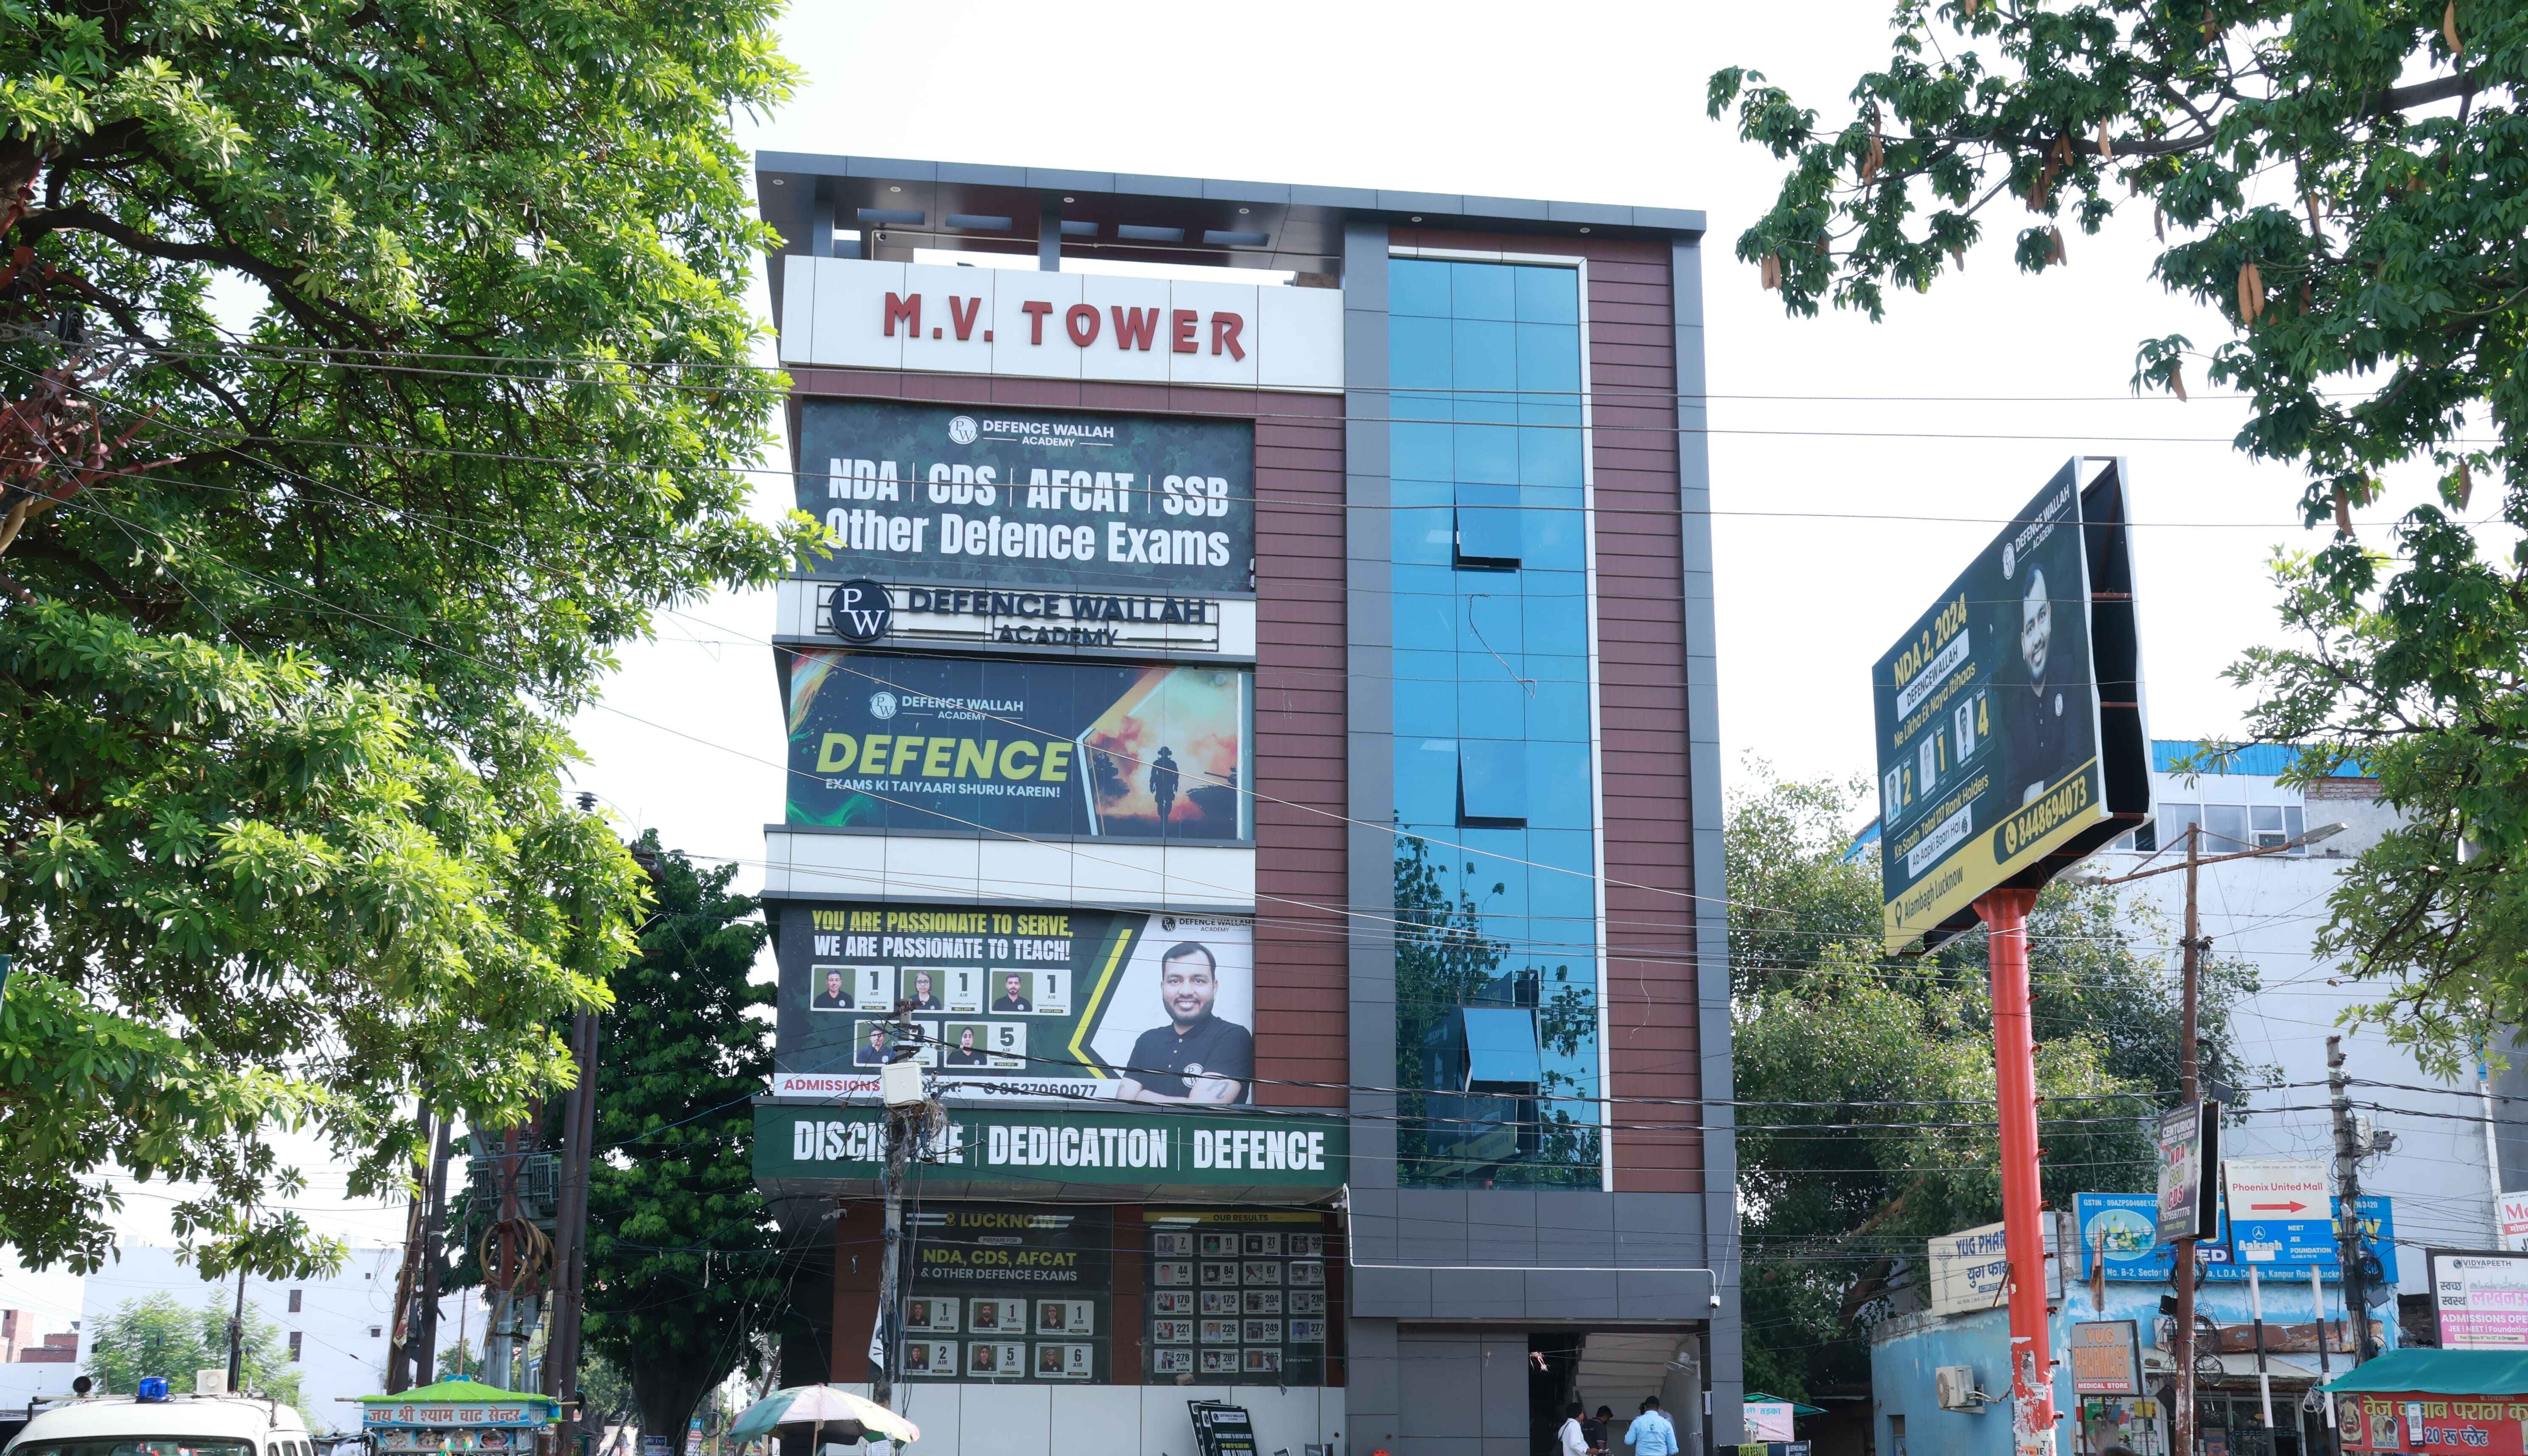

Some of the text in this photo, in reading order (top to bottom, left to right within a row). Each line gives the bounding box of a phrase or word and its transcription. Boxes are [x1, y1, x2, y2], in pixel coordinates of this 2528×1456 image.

[885, 292, 1246, 362] M.V. TOWER
[983, 420, 1114, 438] DEFENCE WALLAH
[1022, 436, 1075, 447] ACADEMY
[829, 458, 1229, 517] NDA CDS AFCAT SSB
[2016, 483, 2070, 553] DEFENCE WALLAH
[826, 508, 1230, 566] Other Defence Exams
[2033, 519, 2055, 551] ACADEMY
[908, 587, 1206, 624] DEFENCE WALLAH
[997, 624, 1119, 647] ACADEMY
[1894, 592, 1967, 691] NDA 2, 2024
[902, 696, 1024, 712] DEFENCE WALLAH
[1894, 662, 1976, 749] Ne Likha Ek Naya Itihaas
[938, 711, 987, 721] ACADEMY
[1977, 697, 1989, 737] 4
[816, 732, 1074, 782] DEFENCE
[1937, 734, 1945, 772] 1
[826, 779, 1061, 798] EXAMS KI TAIYAARI SHURU KAREIN!
[1903, 768, 1912, 806] 2
[1894, 842, 1902, 860] Ke
[1902, 828, 1920, 853] Saath
[1921, 813, 1936, 837] Total
[1936, 805, 1944, 826] 127
[1946, 793, 1962, 818] Rank
[1962, 774, 1989, 805] Holders
[2018, 775, 2087, 846] 8448694073
[1912, 817, 1960, 868] Ab Aapki Baari Hai
[1905, 866, 1963, 921] Alambagh Lucknow
[812, 910, 1074, 938] YOU ARE PASSIONATE TO SERVE,
[1218, 919, 1251, 927] WALLAH
[814, 935, 1070, 961] WE ARE PASSIONATE TO TEACH!
[870, 971, 879, 990] 1
[959, 973, 968, 992] 1
[1047, 975, 1055, 993] 1
[1000, 1027, 1014, 1046] 5
[783, 1079, 880, 1092] ADMISSIONS
[2162, 1116, 2195, 1139] CENTURION
[988, 1126, 1325, 1171] DEDICATION DEFENCE
[2170, 1142, 2185, 1166] NDA
[2169, 1163, 2185, 1188] SSB
[2232, 1182, 2323, 1191] Phoenix United Mall
[2168, 1184, 2184, 1209] CDS
[960, 1213, 1055, 1229] LUCKNOW
[1180, 1237, 1186, 1246] 7
[1226, 1237, 1232, 1246] 11
[1267, 1236, 1275, 1245] 21
[1956, 1237, 1976, 1260] YUG
[2238, 1239, 2283, 1251] Aakash
[923, 1249, 1077, 1267] NDA, CDS, AFCAT
[921, 1268, 1078, 1281] & OTHER DEFENCE EXAMS
[1178, 1264, 1188, 1274] 44
[1967, 1265, 1985, 1289] युग
[2107, 1268, 2119, 1276] No.
[2138, 1268, 2161, 1277] Sector
[2269, 1270, 2294, 1279] Kanpur
[2439, 1281, 2462, 1291] स्वच्छ
[1177, 1294, 1190, 1304] 170
[1223, 1294, 1236, 1304] 175
[1265, 1294, 1279, 1303] 204
[2441, 1296, 2467, 1305] स्वस्थ
[941, 1302, 947, 1316] 1
[1009, 1304, 1015, 1317] 1
[1076, 1305, 1082, 1319] 1
[2441, 1314, 2507, 1323] ADMISSIONS
[1176, 1323, 1190, 1333] 221
[1223, 1323, 1236, 1333] 226
[1265, 1323, 1279, 1333] 249
[1311, 1323, 1324, 1333] 277
[2085, 1327, 2114, 1344] YUG
[939, 1346, 947, 1359] 2
[1006, 1347, 1014, 1361] 5
[1074, 1349, 1081, 1362] 6
[1176, 1353, 1190, 1362] 278
[1223, 1353, 1235, 1362] 281
[2074, 1344, 2128, 1379] PHARMACY
[368, 1405, 521, 1423] जय श्री श्याम चाट सेन्टर
[2363, 1395, 2504, 1421] वेज पराठा
[2425, 1425, 2489, 1446] 20 प्लेट
[1740, 1445, 1766, 1456] OUR RESULT
